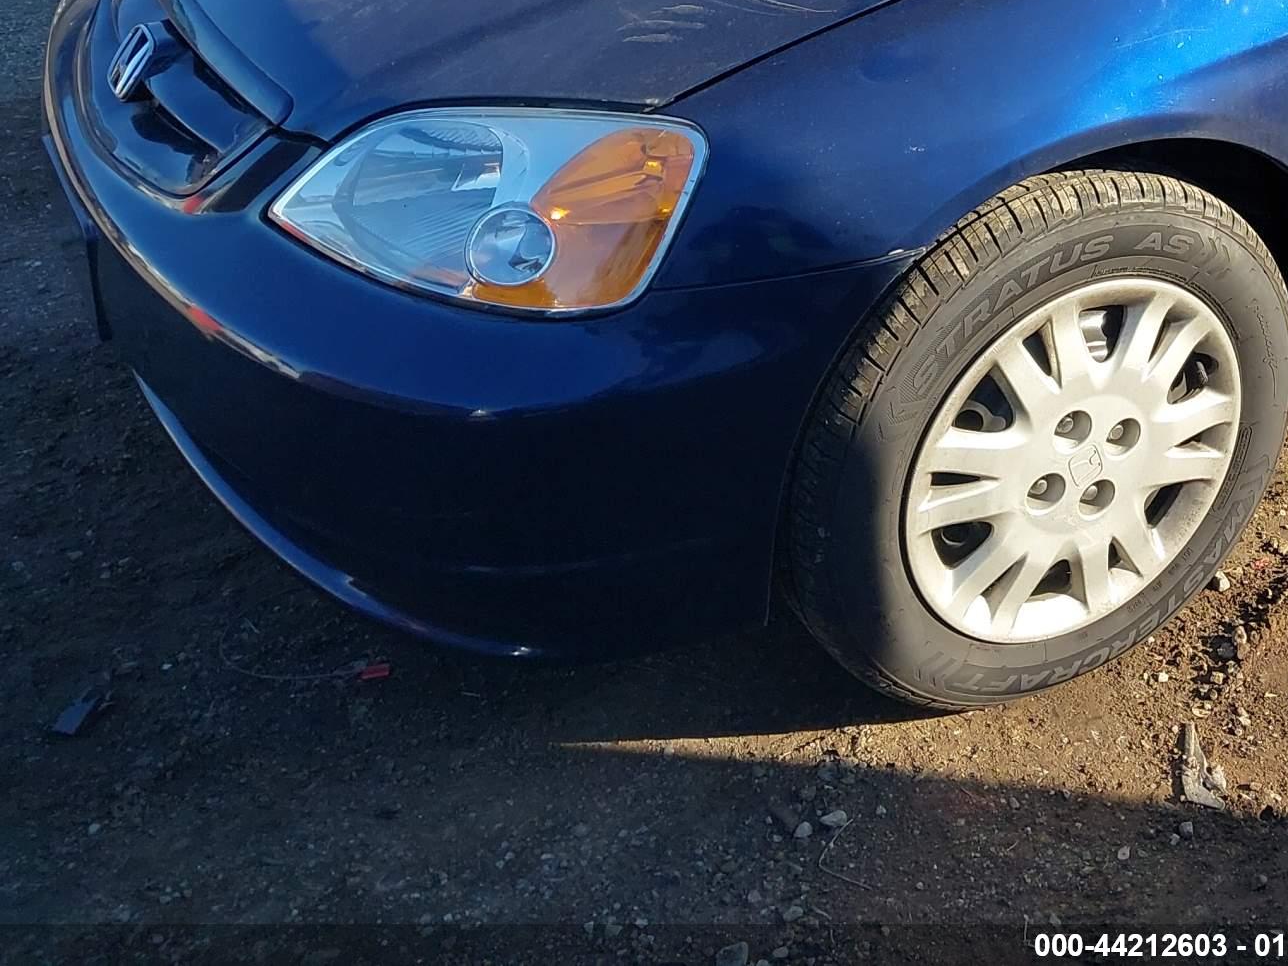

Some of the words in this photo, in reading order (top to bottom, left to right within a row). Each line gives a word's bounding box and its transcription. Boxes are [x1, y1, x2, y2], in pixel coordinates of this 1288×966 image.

[912, 231, 1115, 389] STRATUS
[1134, 230, 1196, 258] AS
[952, 495, 1250, 695] MASTERCRAFT
